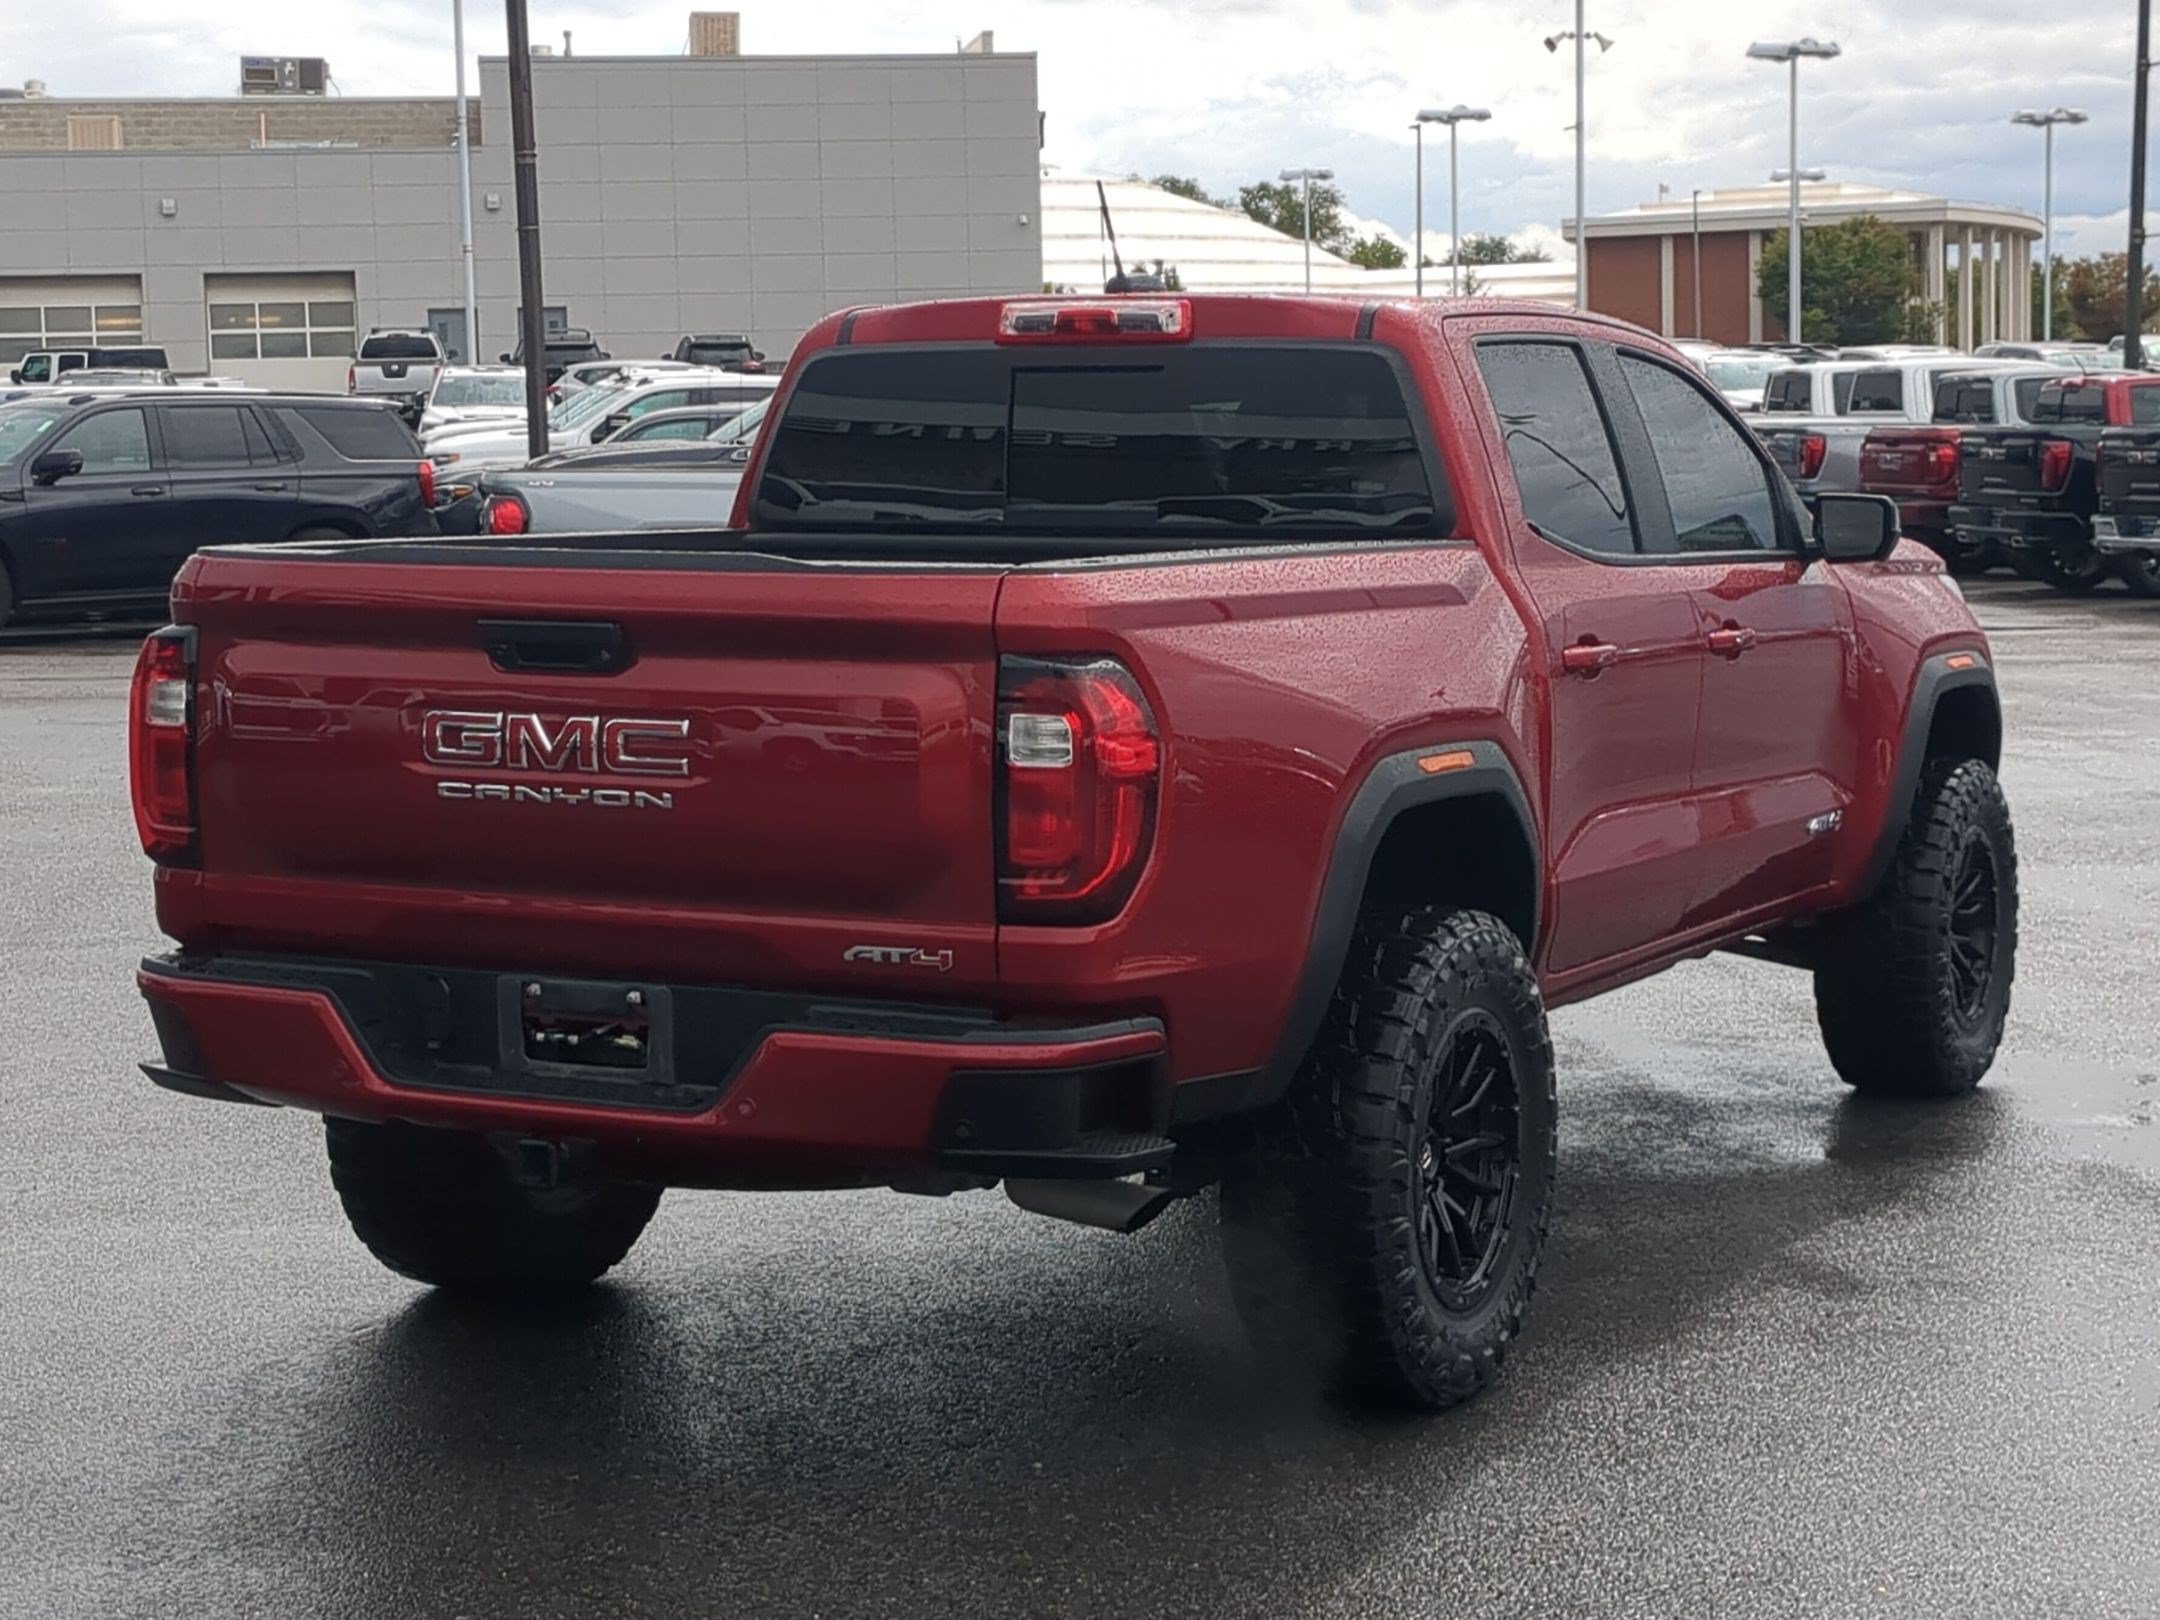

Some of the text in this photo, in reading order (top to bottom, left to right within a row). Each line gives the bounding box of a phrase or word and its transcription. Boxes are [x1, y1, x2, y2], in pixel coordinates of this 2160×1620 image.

[422, 709, 690, 776] GMC
[437, 781, 673, 809] CANYON
[843, 945, 953, 972] AT4
